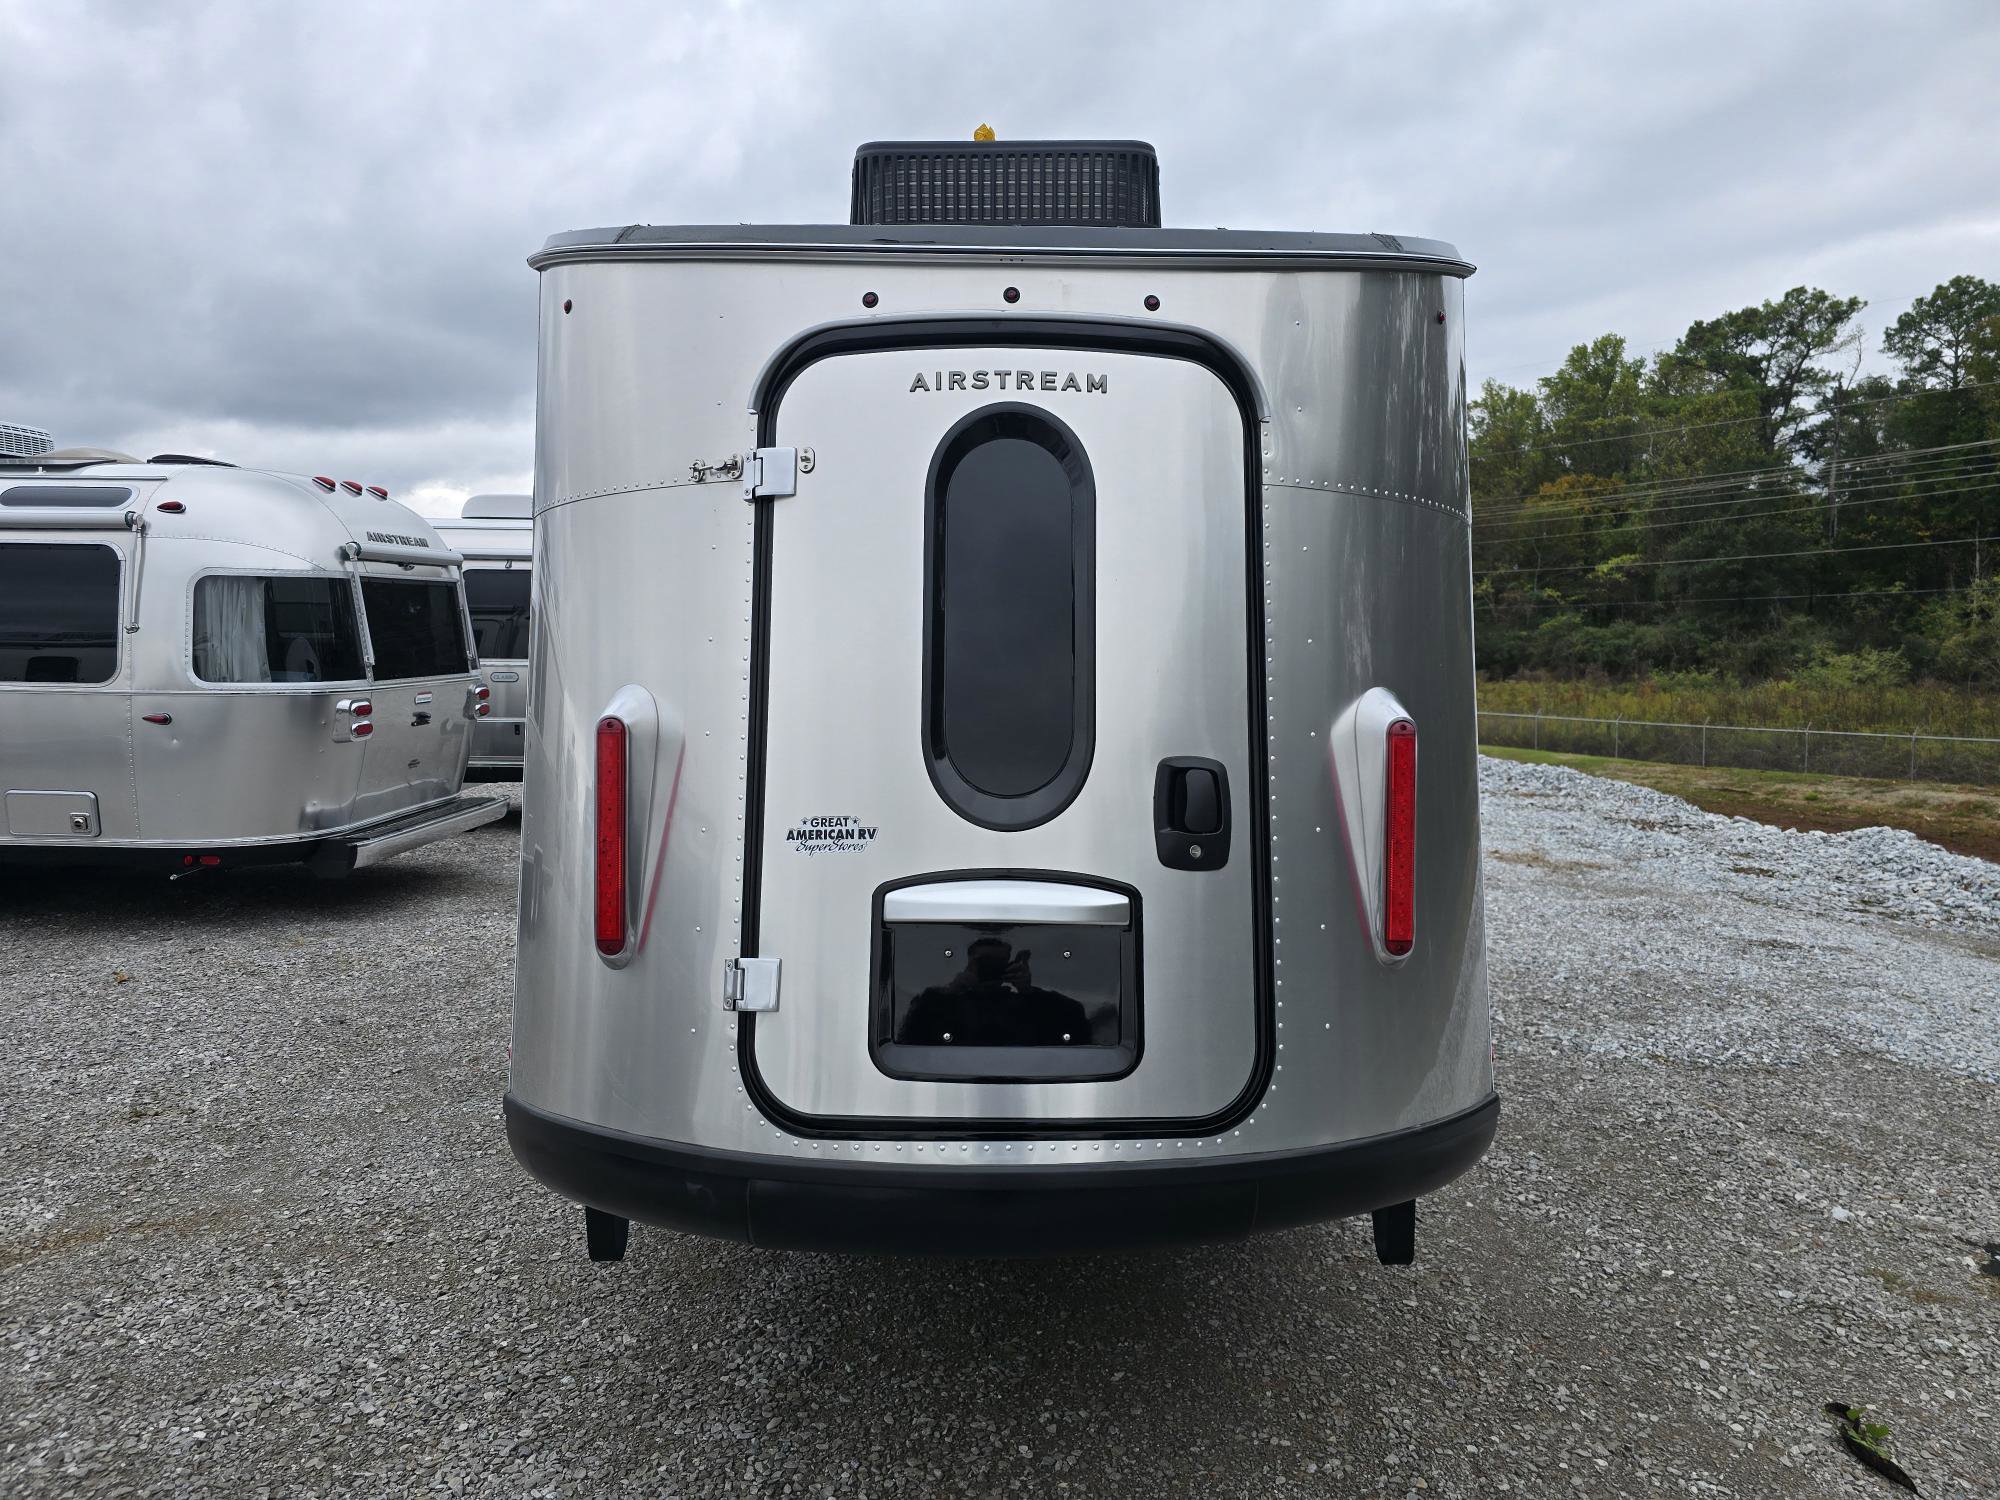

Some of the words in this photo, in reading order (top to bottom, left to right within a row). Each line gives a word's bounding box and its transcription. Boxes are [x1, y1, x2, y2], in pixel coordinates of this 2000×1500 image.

[909, 370, 1108, 394] AIRSTREAM
[366, 531, 429, 548] AIRSTREAM
[810, 817, 850, 828] GREAT
[786, 828, 855, 841] AMERICAN
[858, 828, 877, 840] RV
